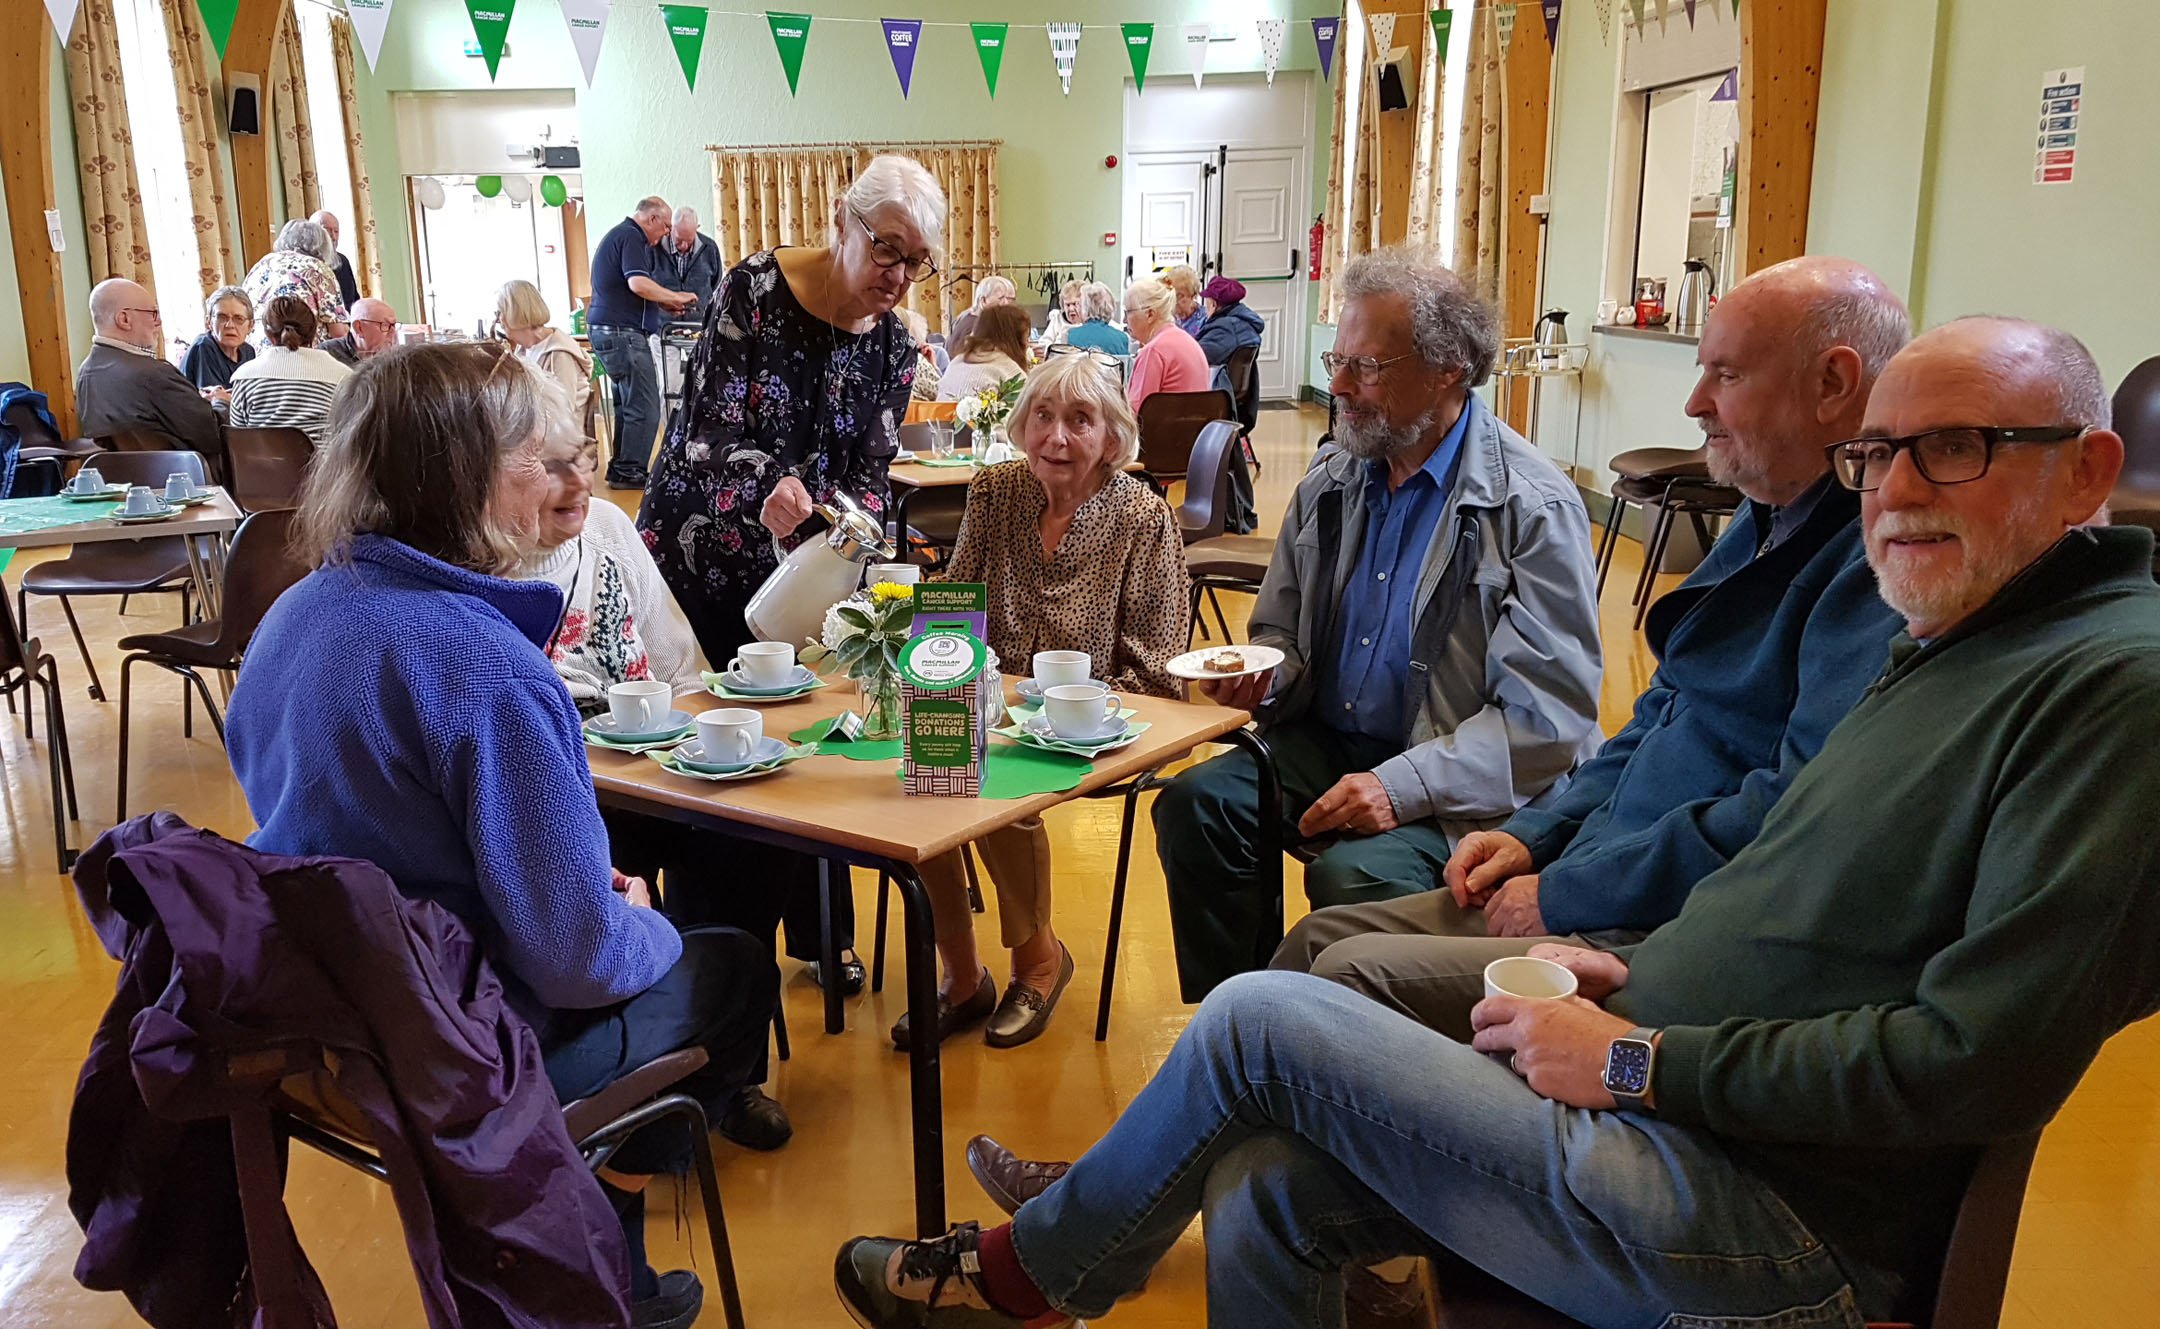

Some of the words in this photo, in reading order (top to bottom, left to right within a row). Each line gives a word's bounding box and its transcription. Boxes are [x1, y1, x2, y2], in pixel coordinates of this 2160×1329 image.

[890, 33, 912, 42] COFFEE
[921, 591, 977, 599] MACMILLAN
[921, 631, 943, 640] Coffee
[945, 631, 971, 642] Morning
[914, 719, 965, 727] DONATIONS
[914, 725, 932, 736] GO
[934, 726, 966, 737] HERE
